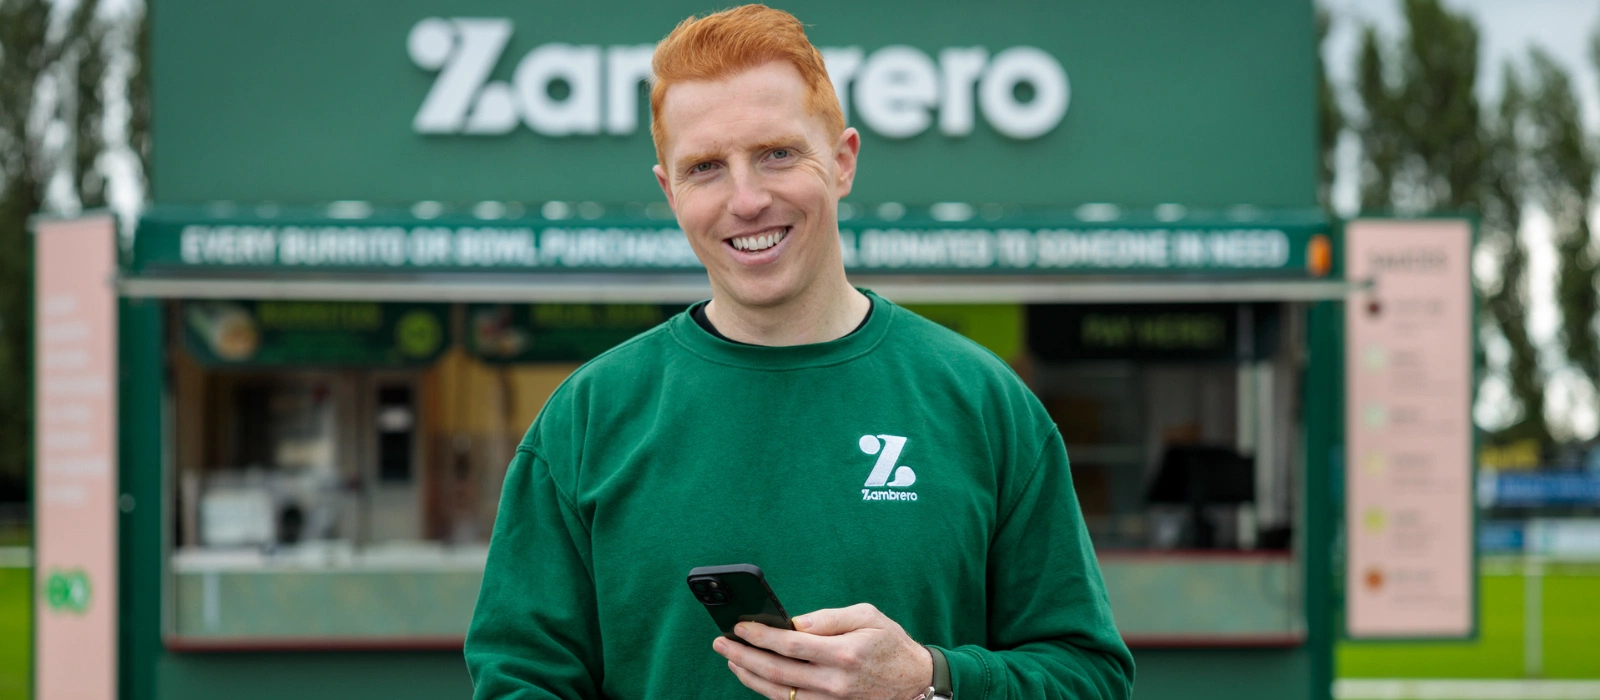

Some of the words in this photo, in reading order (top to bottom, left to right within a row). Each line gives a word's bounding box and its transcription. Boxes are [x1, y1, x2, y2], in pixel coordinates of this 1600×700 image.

[408, 17, 1070, 137] Zarero
[183, 226, 275, 264] EVERY
[280, 226, 405, 265] BURRITO
[456, 227, 538, 265] BOWL
[860, 228, 995, 268] DONATED
[1036, 228, 1170, 268] SOMEONE
[1205, 229, 1288, 268] NEED
[861, 488, 918, 501] Zambrero
